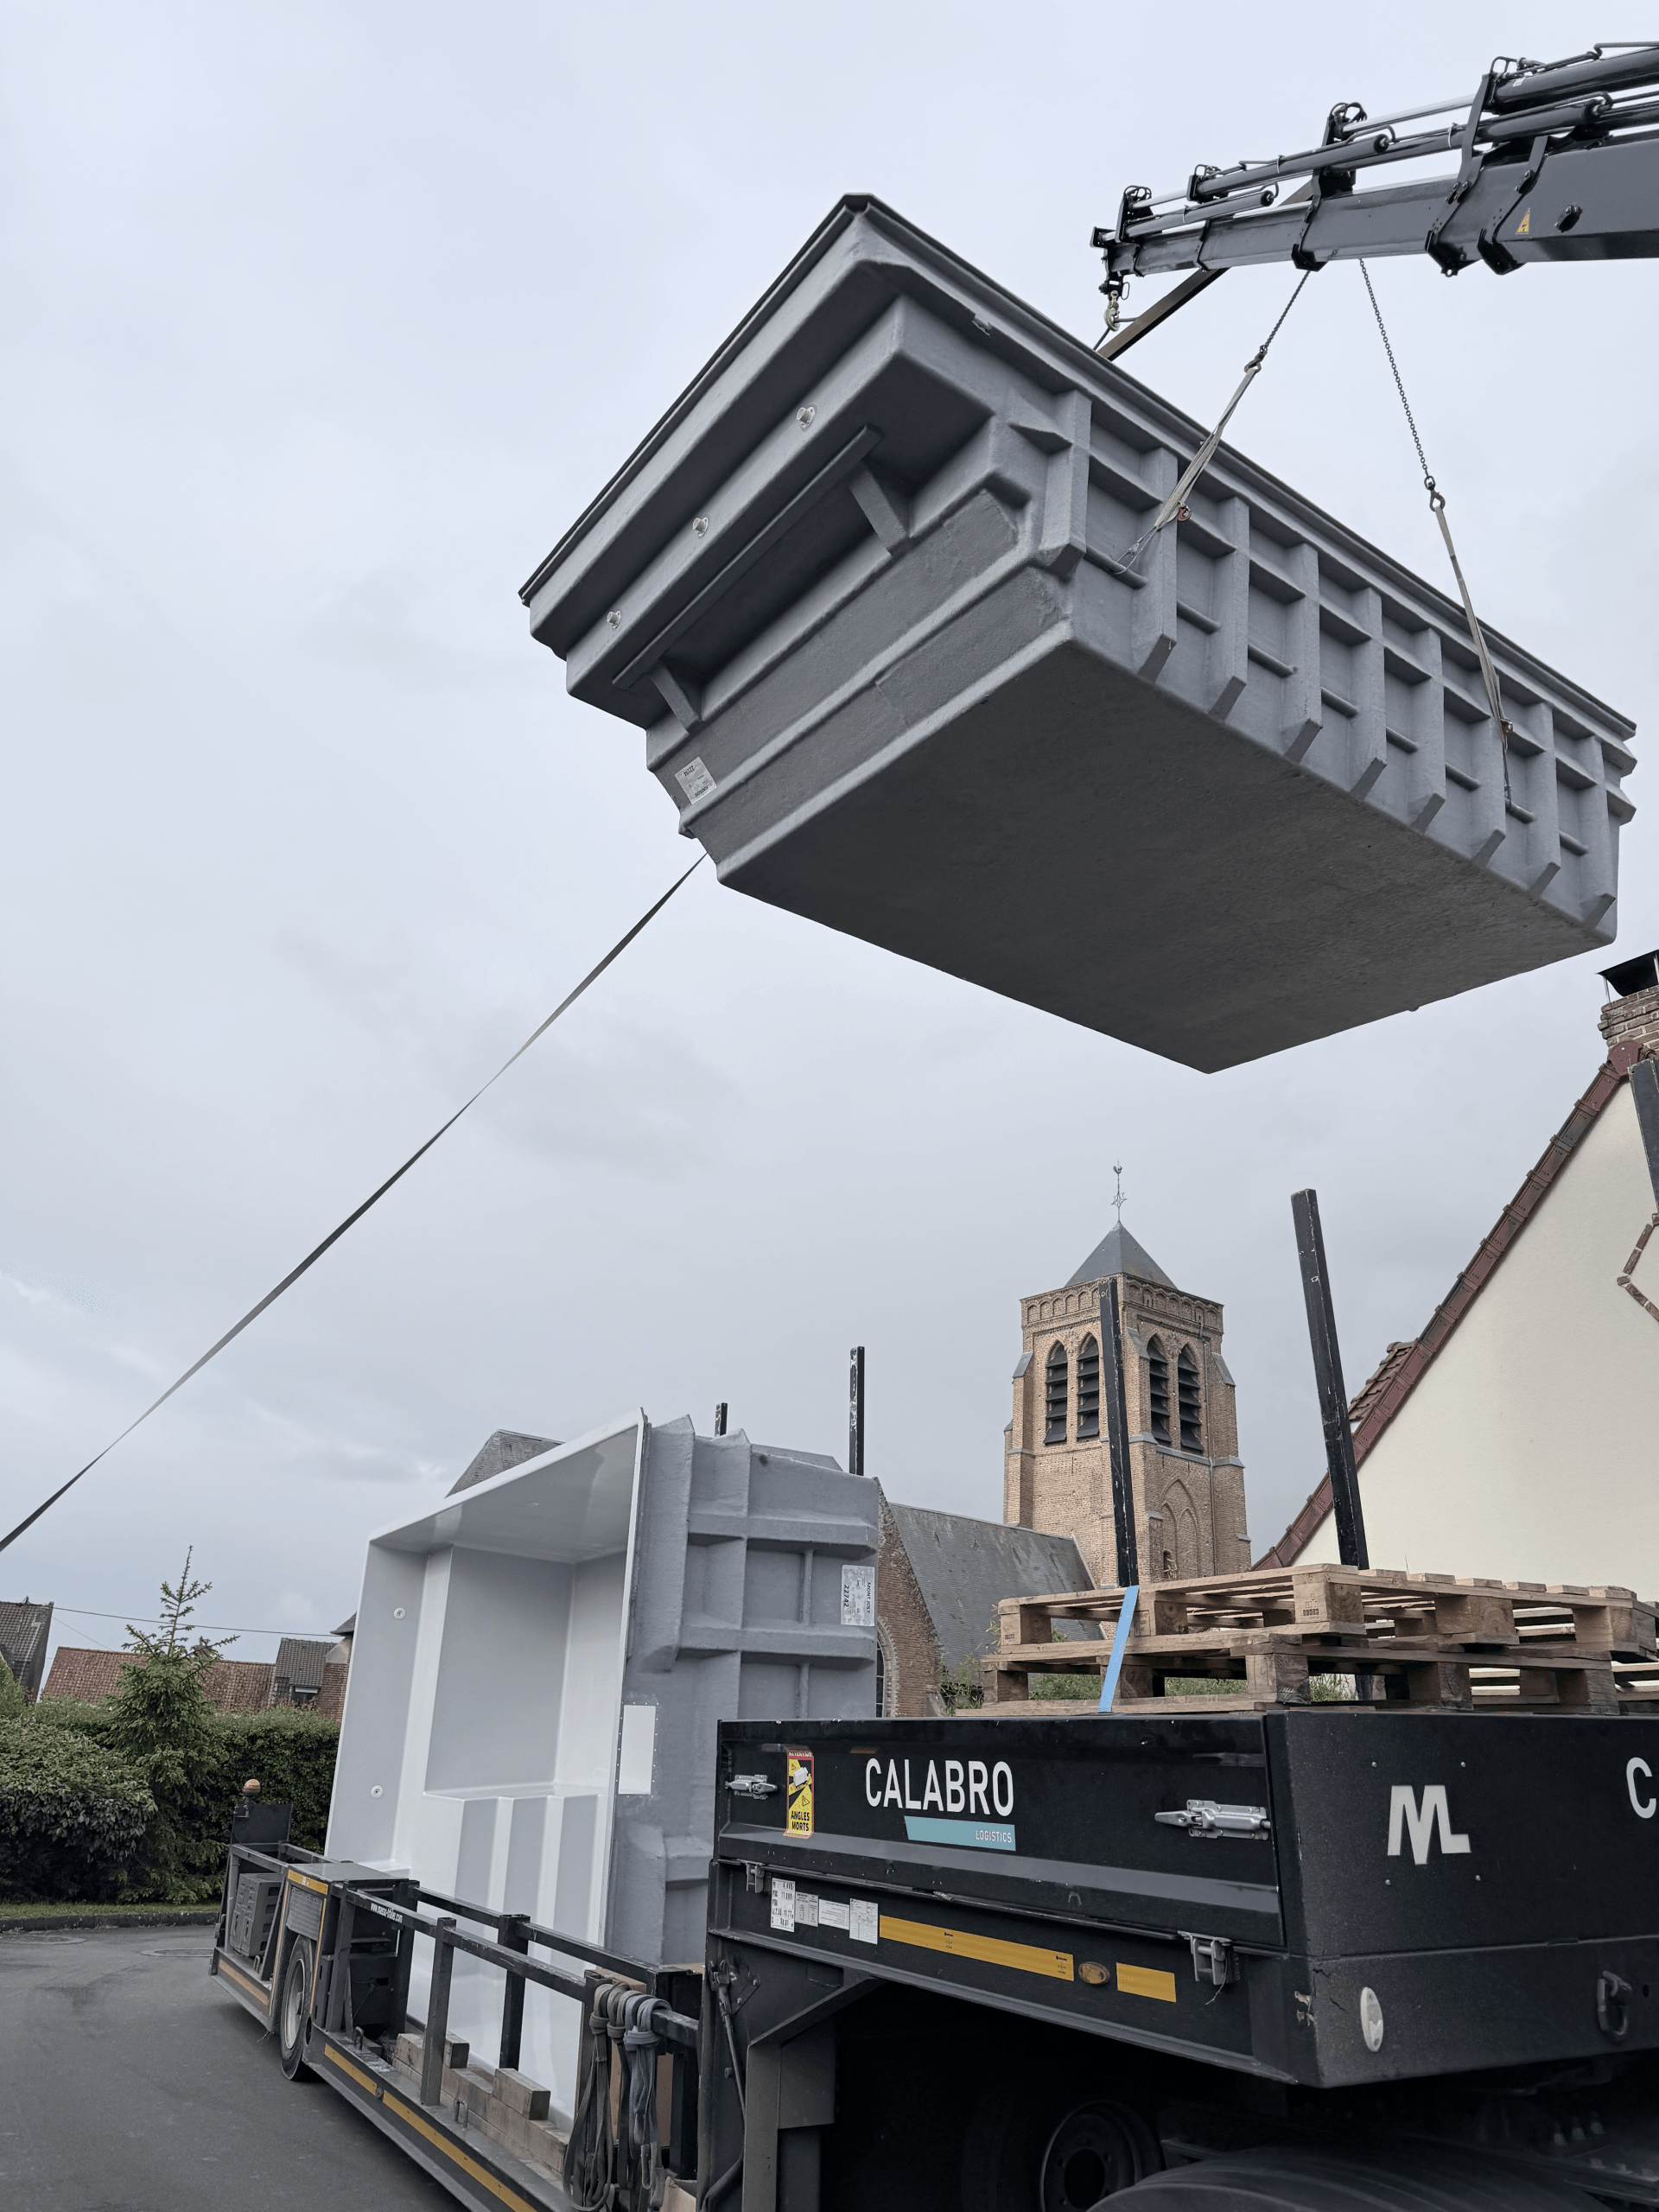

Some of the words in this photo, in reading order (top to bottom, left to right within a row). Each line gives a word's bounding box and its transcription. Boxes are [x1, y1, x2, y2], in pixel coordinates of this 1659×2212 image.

[866, 1758, 1014, 1816] CALABRO
[791, 1810, 810, 1821] ANGLES
[791, 1821, 810, 1832] MORTS
[976, 1829, 1013, 1843] LOGISTICS
